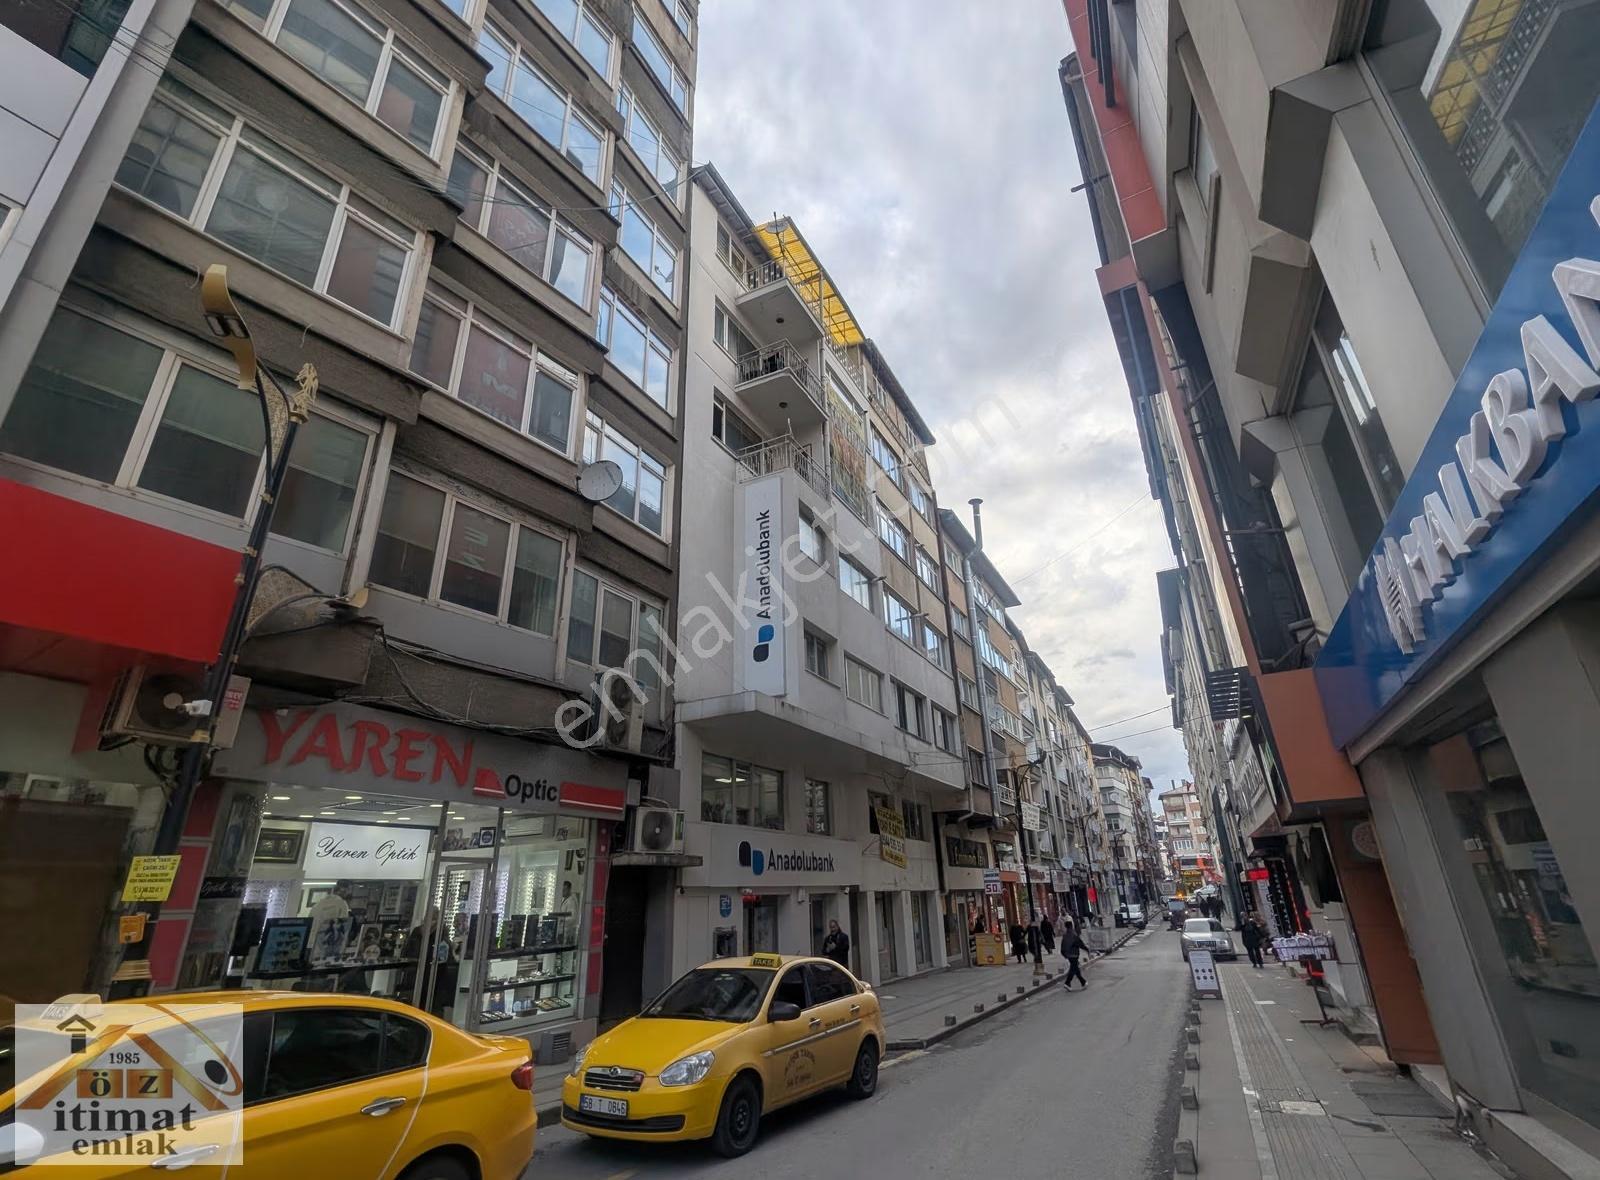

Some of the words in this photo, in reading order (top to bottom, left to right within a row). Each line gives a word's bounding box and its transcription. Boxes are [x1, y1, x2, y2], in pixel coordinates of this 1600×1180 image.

[755, 508, 772, 620] Anadolubank
[257, 708, 474, 788] YAREN
[504, 774, 558, 804] Optic
[315, 836, 370, 859] Yaren
[375, 839, 421, 866] Optik
[767, 848, 835, 873] Anadolubank
[584, 1097, 593, 1110] 58
